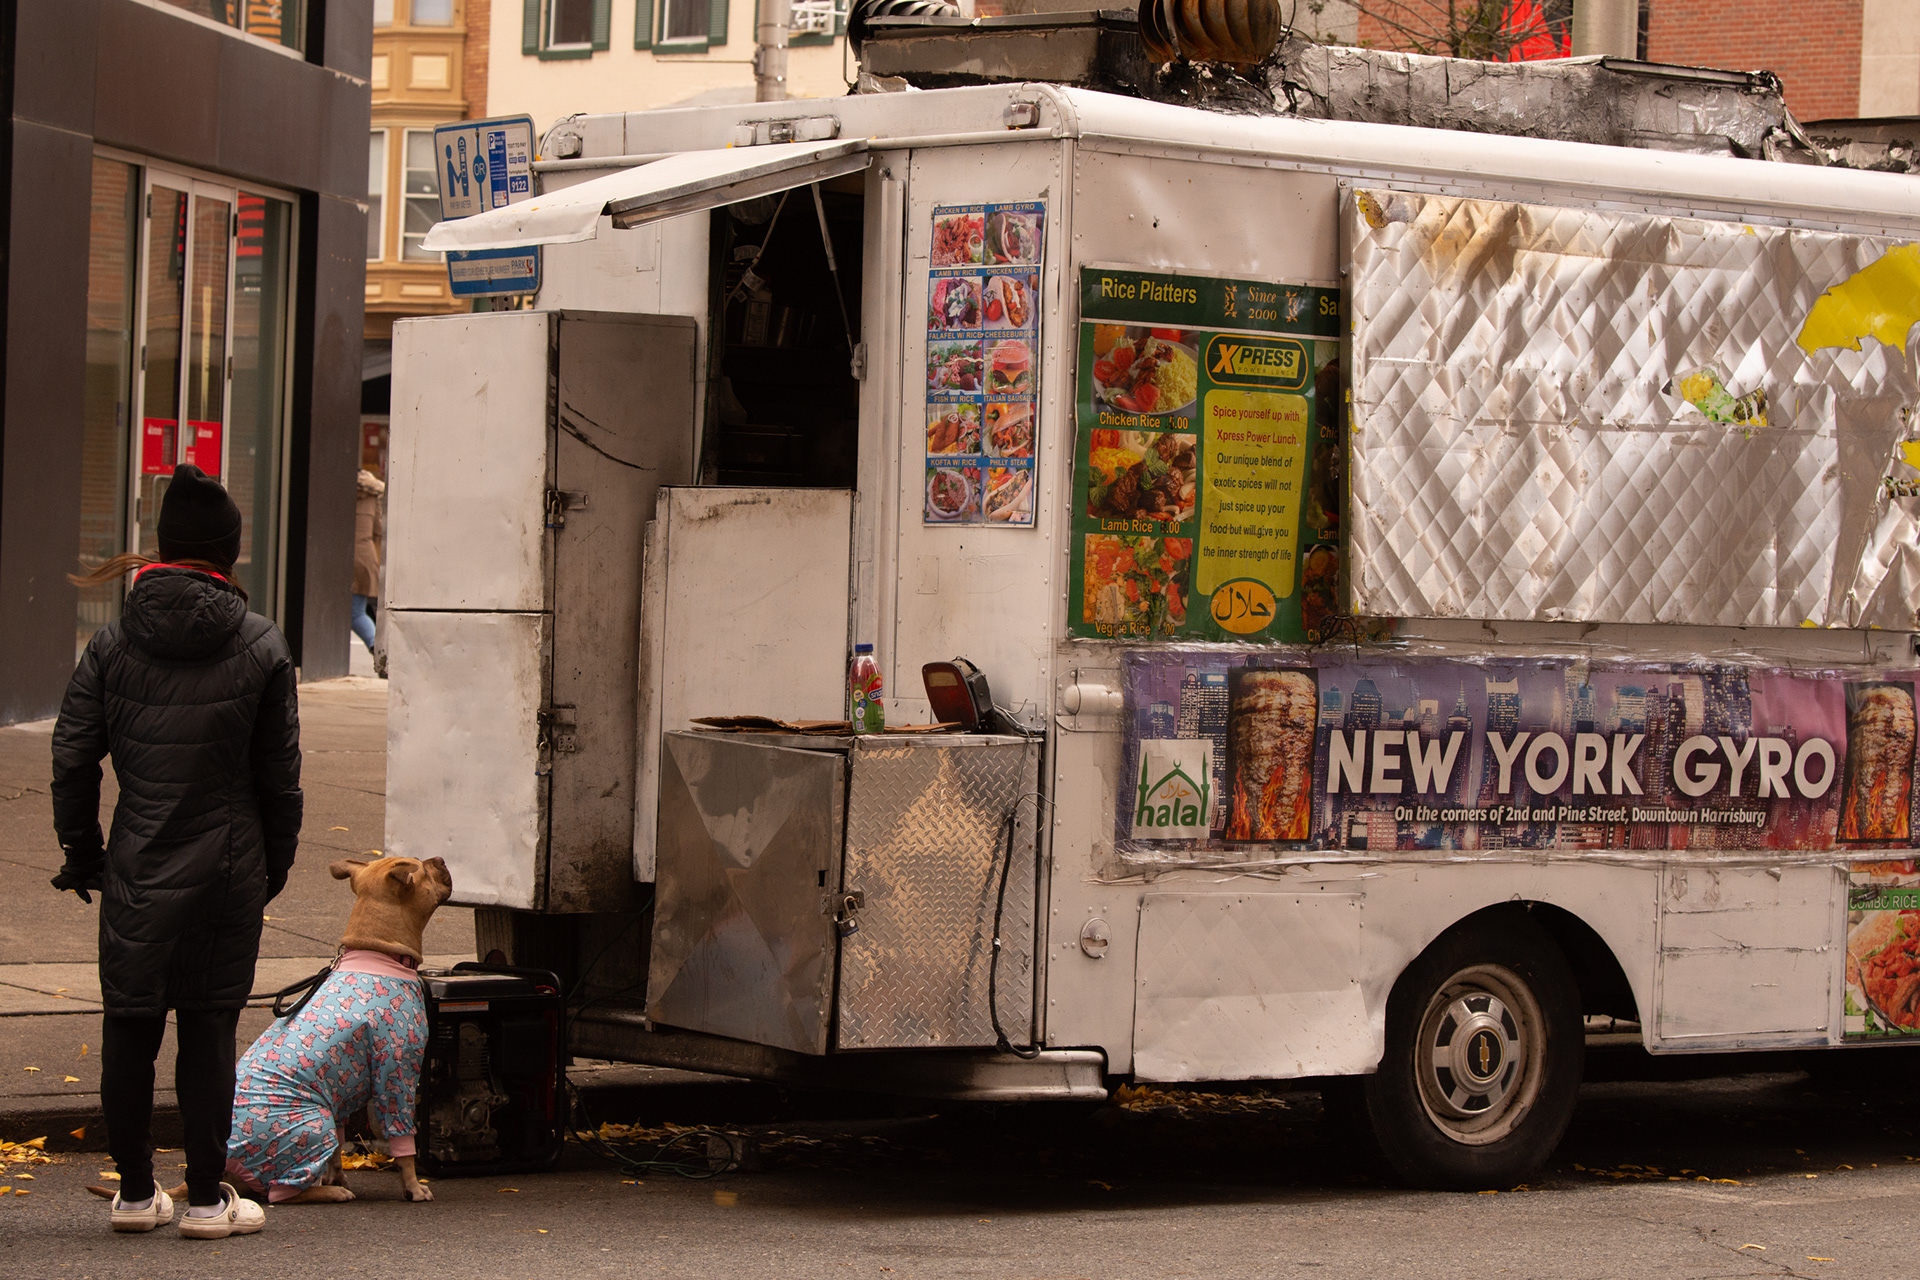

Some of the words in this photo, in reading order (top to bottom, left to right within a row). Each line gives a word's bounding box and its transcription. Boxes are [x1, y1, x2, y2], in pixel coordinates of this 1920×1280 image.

[473, 163, 485, 176] OR
[511, 180, 527, 192] 9122
[994, 204, 1014, 212] LAMB
[511, 260, 526, 270] PARK
[962, 268, 976, 276] RICE
[1024, 266, 1036, 274] PITA
[1101, 277, 1136, 300] Rice
[1139, 280, 1197, 304] Platters
[1247, 286, 1277, 304] Since
[1248, 308, 1277, 321] 2000
[928, 332, 956, 340] FALAFEL
[966, 330, 980, 338] RICE
[984, 330, 1036, 338] CHEESEBURGR
[1211, 344, 1294, 374] XPRESS
[1008, 394, 1034, 402] SAUSAGE
[1100, 412, 1138, 426] Chicken
[1140, 414, 1160, 428] Rice
[1213, 405, 1237, 419] Spice
[1238, 407, 1270, 422] yourself
[1271, 411, 1282, 422] up
[1284, 409, 1300, 422] with
[1217, 429, 1245, 444] Xpress
[1246, 430, 1270, 444] Power
[1272, 432, 1297, 444] Lunch
[1217, 452, 1232, 465] Our
[1234, 454, 1260, 468] unique
[1261, 454, 1282, 467] blend
[1284, 456, 1293, 468] of
[1214, 476, 1236, 489] exotic
[1238, 478, 1262, 492] spices
[1264, 478, 1278, 490] will
[1279, 480, 1292, 491] not
[1219, 500, 1234, 513] just
[1235, 501, 1255, 514] spice
[1256, 504, 1266, 514] up
[1267, 504, 1285, 516] your
[1101, 518, 1130, 532] Lamb
[1132, 519, 1153, 533] Rice
[1209, 523, 1228, 535] food
[1228, 524, 1242, 536] but
[1244, 524, 1256, 536] will
[1257, 524, 1273, 539] give
[1274, 528, 1289, 539] you
[1203, 546, 1216, 558] the
[1217, 547, 1237, 559] inner
[1238, 548, 1270, 562] strength
[1270, 548, 1280, 560] of
[1280, 548, 1292, 561] life
[1215, 587, 1271, 622] حلال
[1095, 621, 1127, 638] Vegie
[1130, 622, 1151, 635] Rice
[1326, 729, 1465, 794] NEW
[1486, 730, 1644, 796] YORK
[1672, 734, 1836, 799] GYRO
[1160, 780, 1191, 799] حلال
[1136, 797, 1206, 827] halal
[1394, 806, 1413, 822] On
[1416, 806, 1438, 822] the
[1440, 809, 1487, 823] corners
[1489, 806, 1504, 825] of
[1506, 806, 1530, 823] 2nd
[1532, 806, 1556, 823] and
[1558, 807, 1586, 823] Pine
[1588, 808, 1629, 826] Street,
[1632, 808, 1698, 824] Downtown
[1701, 809, 1766, 827] Harrisburg
[1892, 895, 1918, 908] RICE
